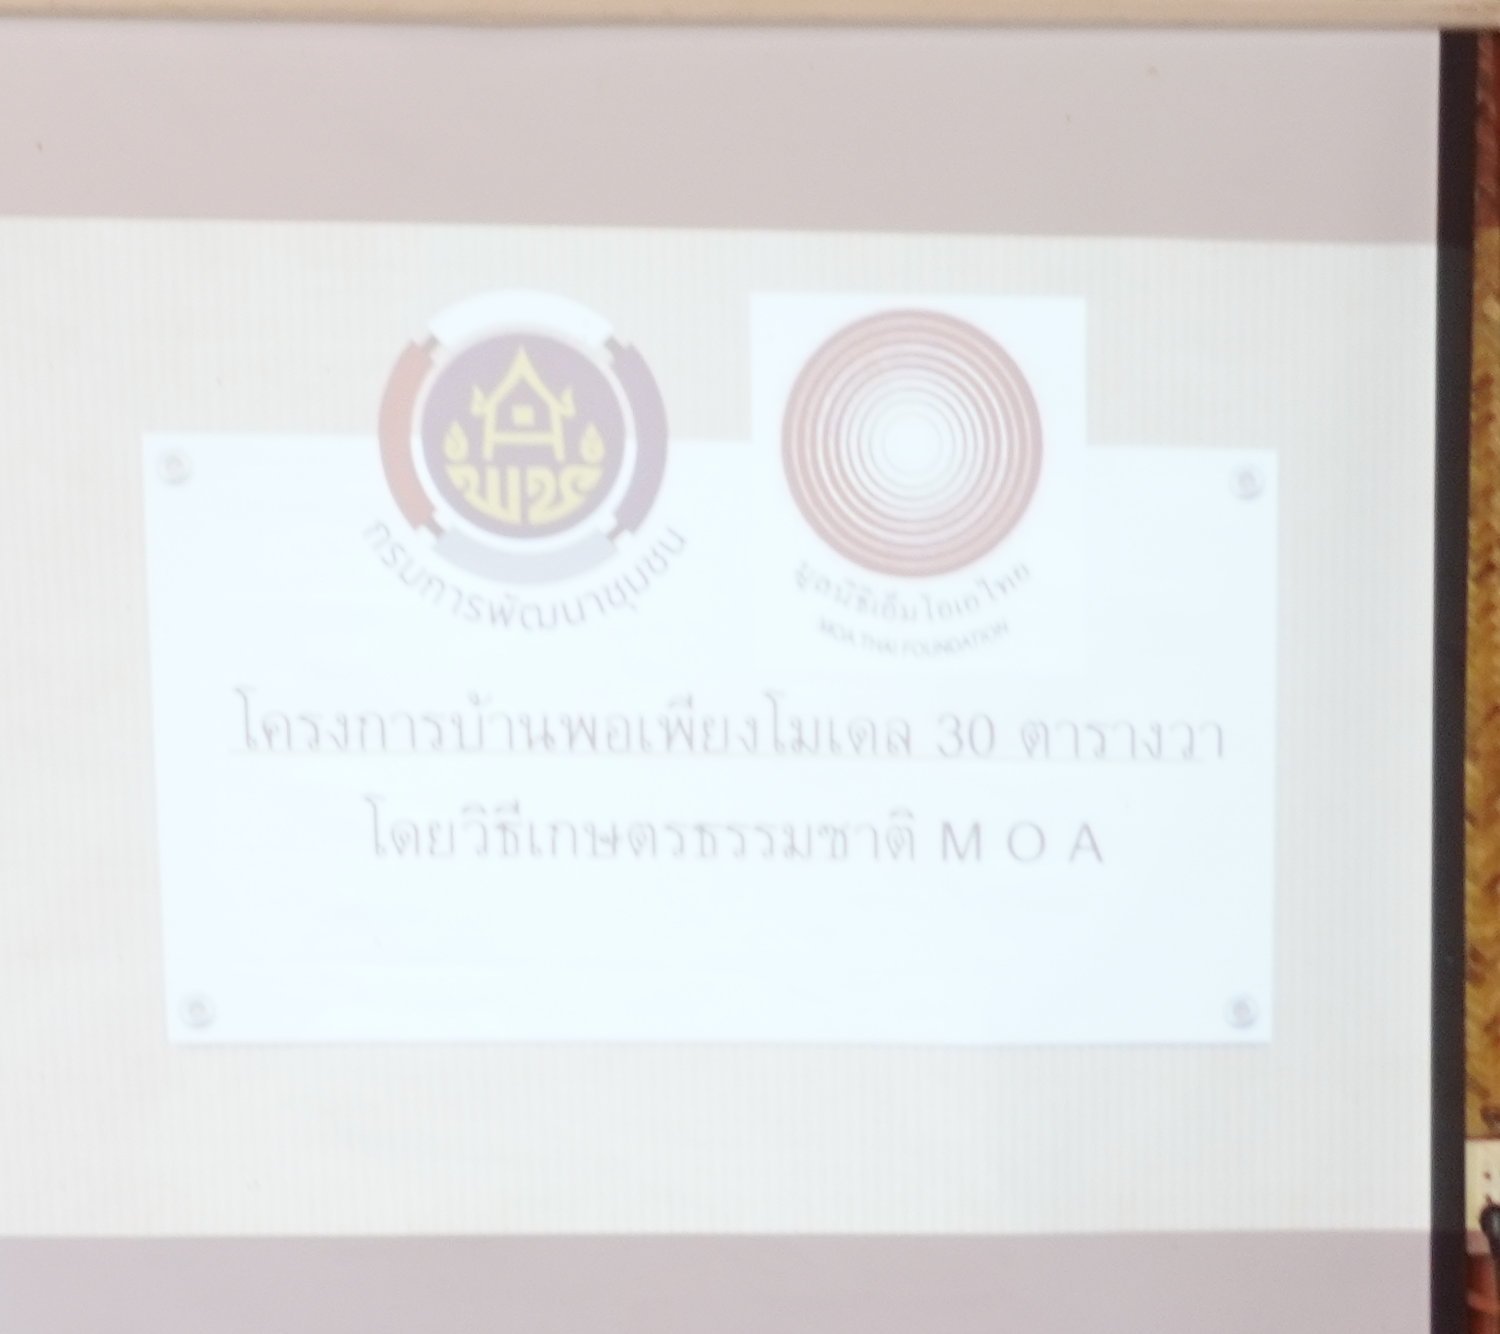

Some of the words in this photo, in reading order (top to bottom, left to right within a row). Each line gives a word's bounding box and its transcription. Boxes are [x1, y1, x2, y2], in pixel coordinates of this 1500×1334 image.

[362, 519, 687, 630] กรมการพัฒนาชุมชน
[934, 711, 997, 759] 30
[1019, 716, 1226, 761] ตารางวา
[364, 794, 917, 862] โดยวิธีเกษตรธรรมชาติ
[940, 820, 983, 862] M
